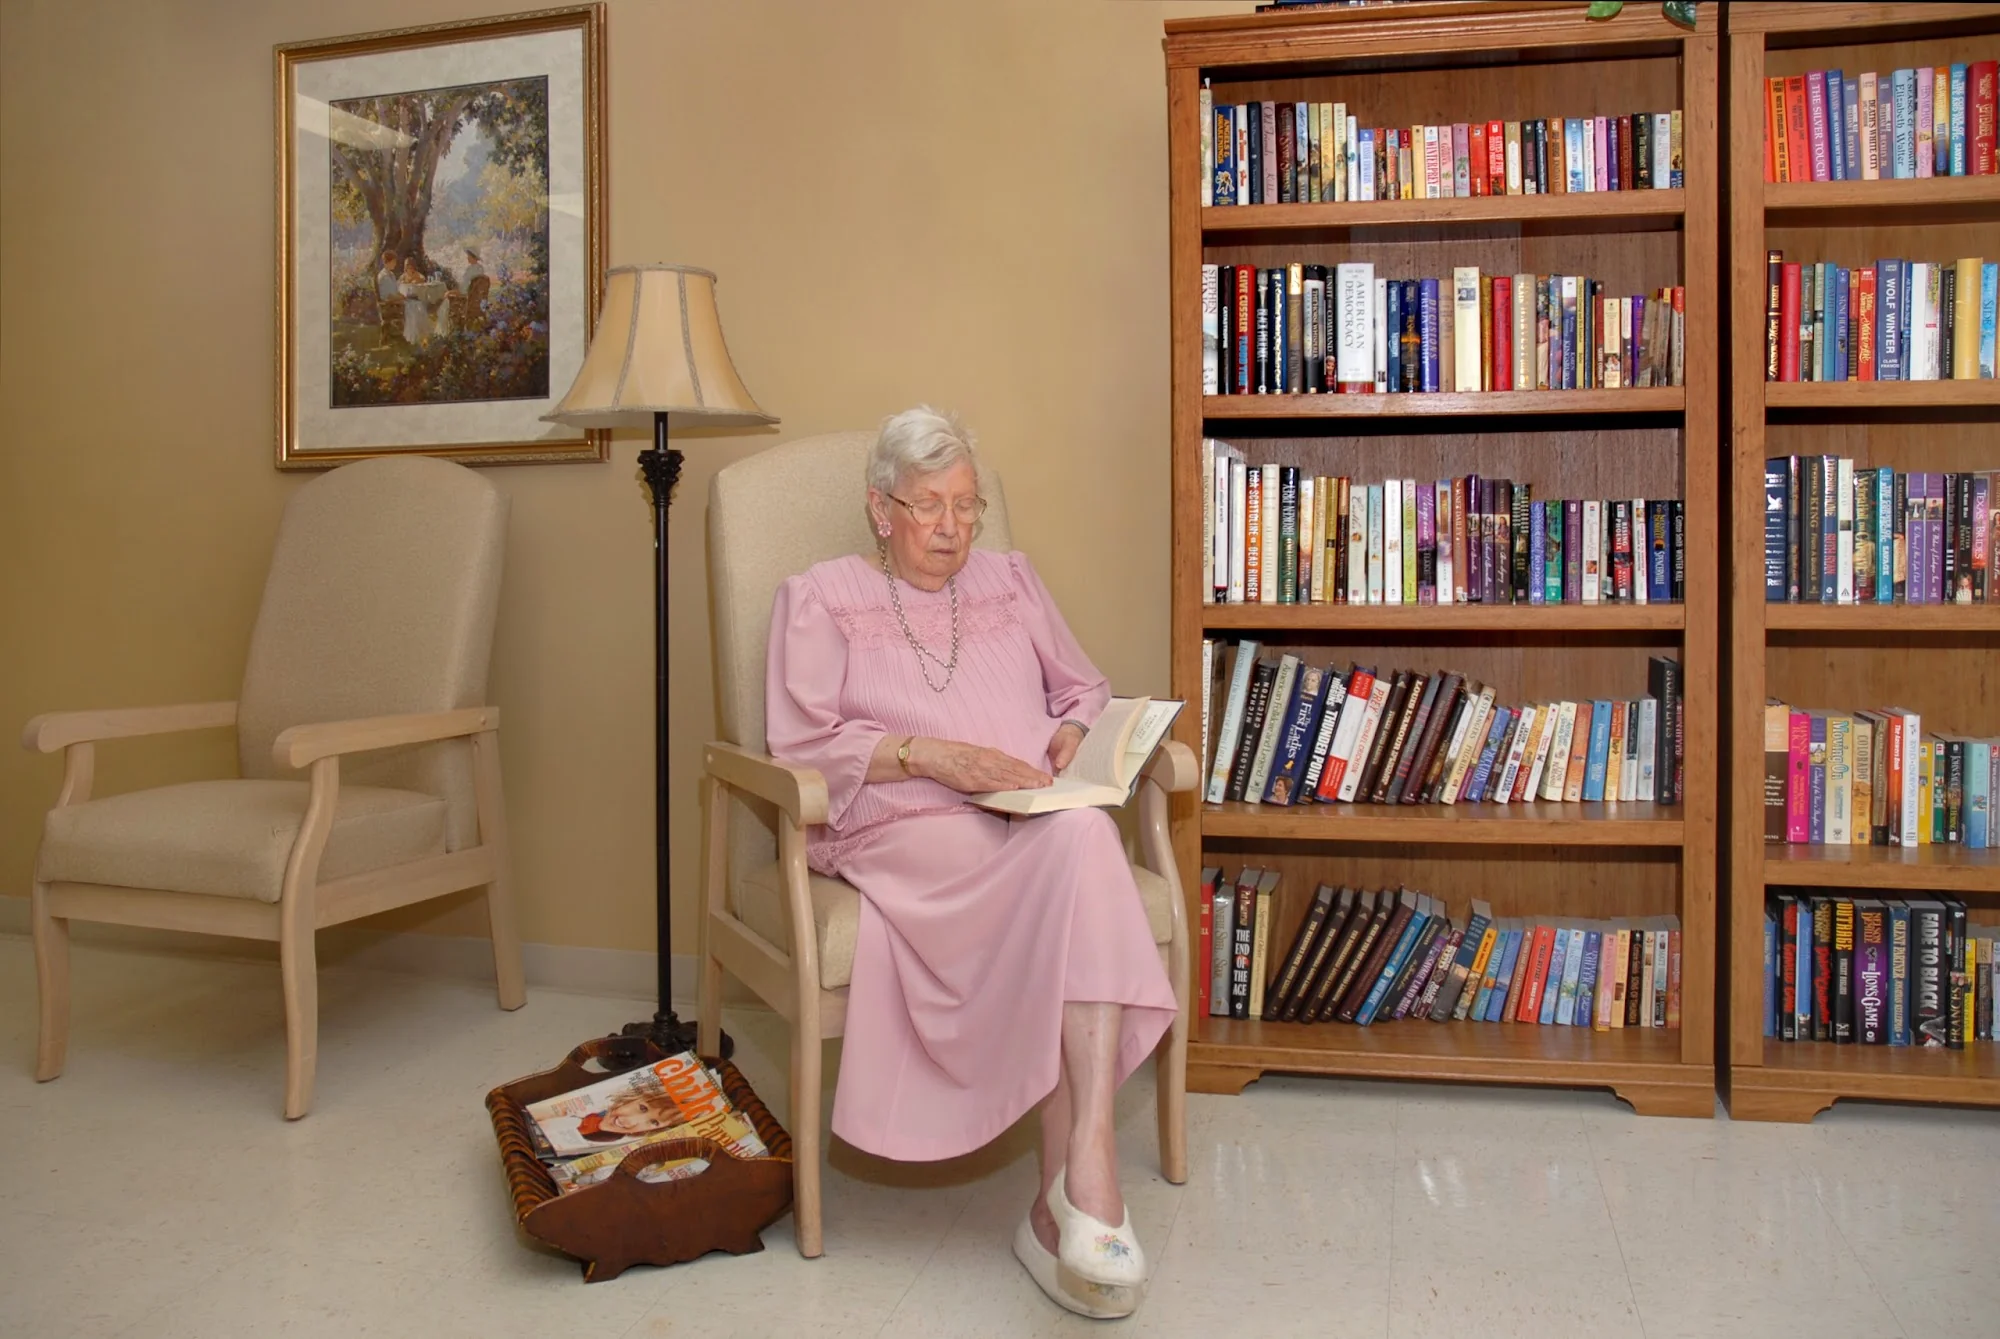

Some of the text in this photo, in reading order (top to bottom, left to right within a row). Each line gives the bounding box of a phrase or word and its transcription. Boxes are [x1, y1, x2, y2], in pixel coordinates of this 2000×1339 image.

[1264, 106, 1274, 156] Old Friends
[1811, 84, 1825, 178] THE SILVER TOUCH
[1868, 99, 1878, 170] DEATH'S WHITE CITY
[1895, 84, 1906, 166] Elizabeth Walter
[1426, 140, 1438, 185] WINTER PREY
[1954, 143, 1962, 173] SAVAGE
[1208, 268, 1217, 314] STEPHEN
[1239, 270, 1248, 293] CLIVE
[1239, 295, 1248, 332] CUSSLER
[1345, 280, 1354, 349] DEMOCRACY
[1356, 280, 1365, 349] AMERICAN
[1429, 298, 1437, 360] DECISIONS
[1839, 317, 1847, 336] HEART
[1885, 278, 1896, 354] WOLF WINTER
[1983, 299, 1994, 326] SIDE
[1239, 336, 1248, 364] FLOOD
[1282, 484, 1296, 535] BROKEN PREY
[1419, 493, 1433, 542] Virginia
[1455, 488, 1463, 536] JANET DAILEY
[1810, 497, 1819, 528] KING
[1975, 490, 1986, 559] TEXAS BRIDES
[1247, 470, 1258, 597] LISA SCOTTOLINE DEAD RINGER
[1675, 515, 1683, 582] Cotton Smith WINTER KILL
[1824, 533, 1836, 575] RUTH RYAN
[1654, 551, 1665, 585] SPENCERVILLE
[1246, 681, 1261, 723] MICHAEL
[1253, 681, 1270, 728] CRICHTON
[1326, 677, 1342, 707] HIGGINS
[1336, 684, 1348, 705] JACK
[1353, 675, 1362, 694] WEAD
[1361, 678, 1370, 697] DOUG
[1666, 670, 1676, 738] STOLEN LIVES
[1255, 663, 1291, 778] American Folklore and Legend
[1287, 702, 1312, 759] First Ladies
[1303, 717, 1312, 727] The
[1351, 687, 1385, 774] PREY MICHAEL CRICHTON
[1392, 679, 1424, 751] LOUIS L'AMOUR
[1515, 721, 1527, 747] MANNING
[1521, 726, 1531, 744] JASON
[1304, 710, 1339, 789] THUNDER POINT
[1456, 700, 1489, 776] STRANGERS PILGRIMS
[1791, 726, 1799, 751] RICE
[1800, 721, 1808, 756] LUANNE
[1828, 721, 1849, 763] Moving
[1857, 735, 1869, 780] COLORADO
[1233, 734, 1253, 791] DISCLOSURE
[1831, 764, 1849, 781] On
[1950, 756, 1960, 772] JOHN
[1236, 929, 1251, 942] THE
[1257, 908, 1267, 959] Significant Others
[1814, 910, 1822, 935] KING
[1835, 902, 1853, 951] OUTRAGE
[1861, 912, 1874, 944] DEMILLE
[1873, 912, 1883, 944] NELSON
[1893, 919, 1906, 945] SILENT
[1235, 943, 1251, 956] END
[1236, 956, 1249, 969] OF
[1839, 958, 1848, 976] VINCENT
[1893, 946, 1905, 979] PARTNER
[1920, 912, 1939, 1010] FADE TO BLACK
[1233, 970, 1249, 982] THE
[1233, 984, 1247, 996] AGE
[1406, 957, 1434, 997] SAVAGE LAND
[1426, 984, 1440, 1004] RALPH
[1861, 962, 1882, 1029] THE LION'S GAME
[1950, 986, 1961, 1043] FRANCES
